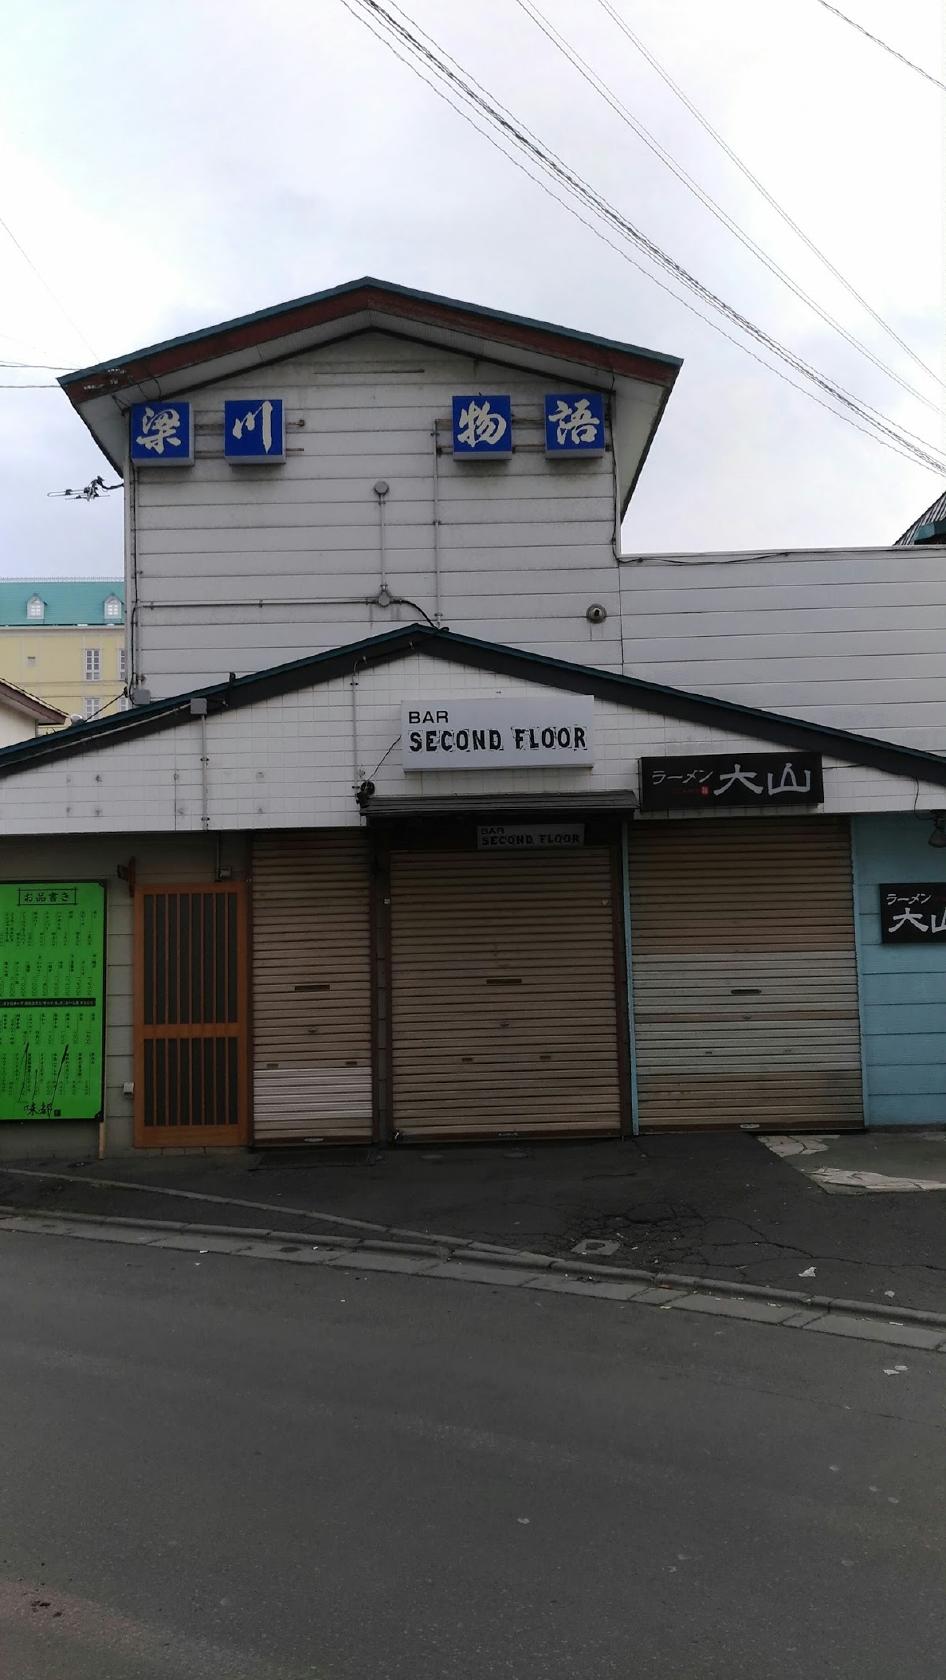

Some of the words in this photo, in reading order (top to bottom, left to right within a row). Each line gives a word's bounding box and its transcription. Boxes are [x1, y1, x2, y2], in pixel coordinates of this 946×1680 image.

[408, 711, 449, 724] BAR
[409, 729, 502, 752] SECOND
[513, 726, 587, 750] FLOOR
[652, 770, 713, 785] ラーメン
[713, 763, 811, 796] 大山
[481, 836, 533, 846] SECOND
[538, 834, 580, 844] FLOOR
[886, 893, 932, 905] ラーメン
